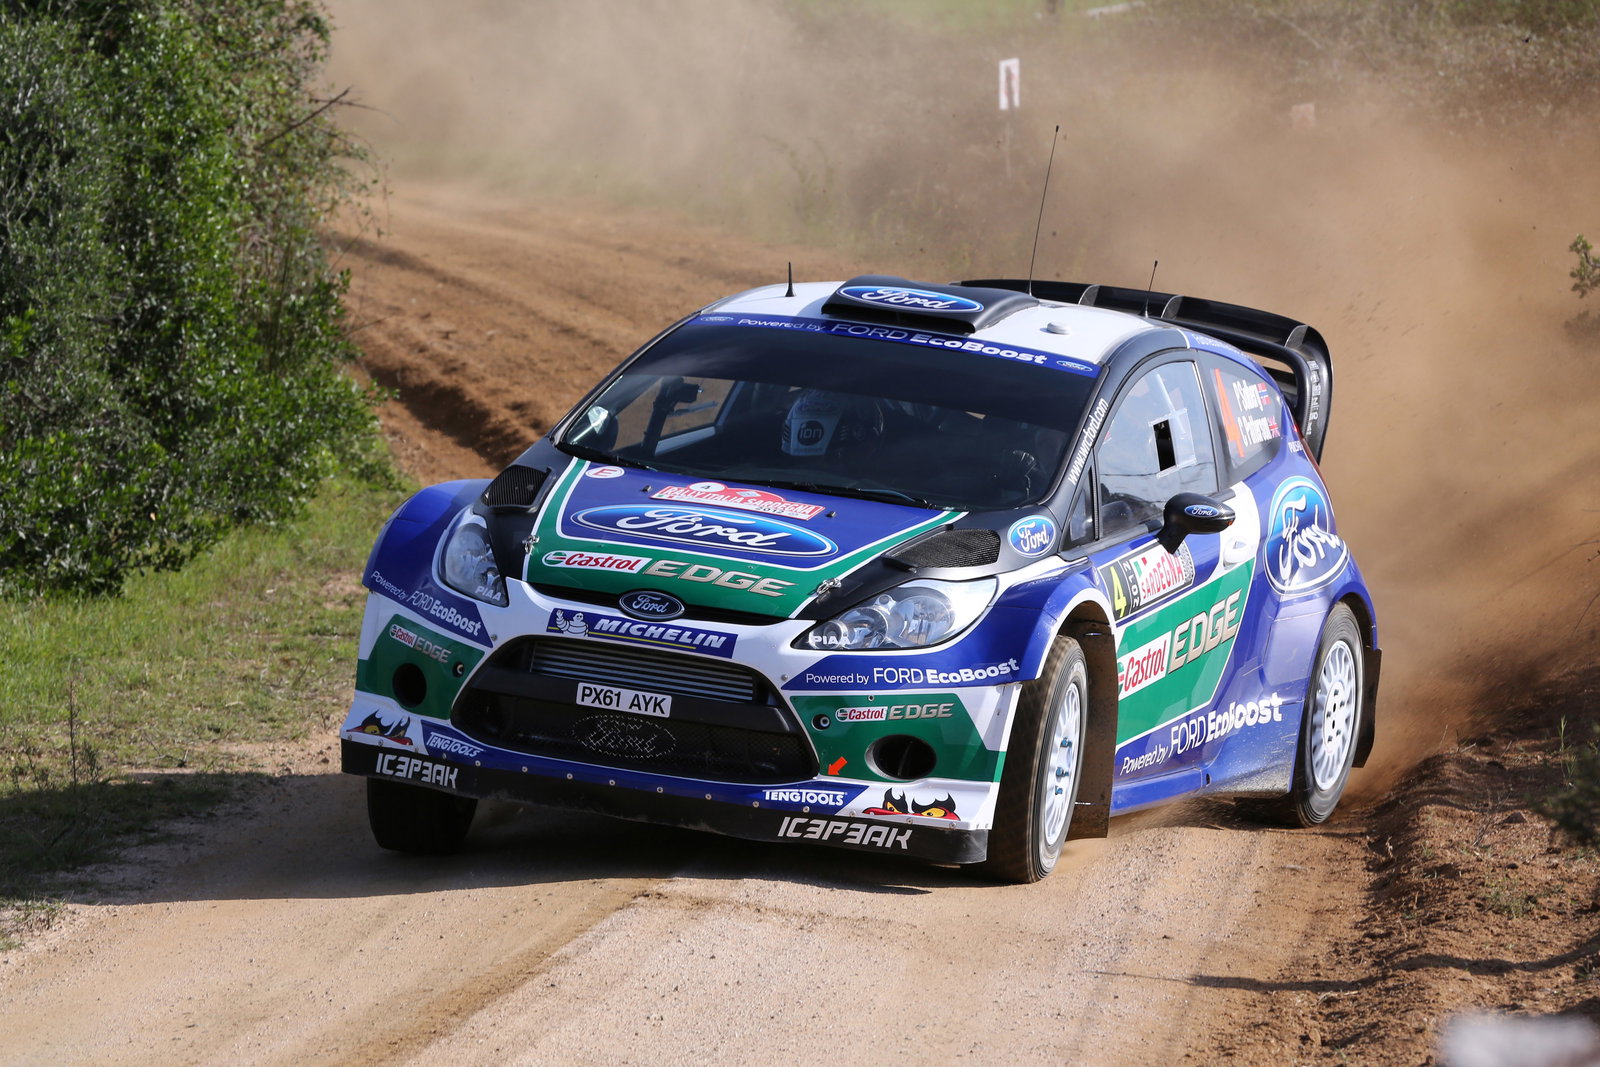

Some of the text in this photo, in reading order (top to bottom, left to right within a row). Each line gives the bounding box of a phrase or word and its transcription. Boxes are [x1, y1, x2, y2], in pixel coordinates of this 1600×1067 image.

[861, 288, 957, 309] Ford
[738, 318, 803, 329] Powered
[806, 322, 827, 332] by
[830, 323, 908, 341] FORD
[909, 334, 1047, 365] EcoBoost
[1068, 398, 1109, 486] www.wrcford.com
[594, 467, 617, 477] E
[664, 486, 817, 514] RALLY ITALIA SARDEGNA
[1191, 507, 1213, 516] Ford
[617, 507, 793, 549] Ford
[1018, 522, 1050, 552] Ford
[1279, 494, 1341, 588] Ford
[563, 553, 800, 597] Castrol EDGE
[1141, 552, 1185, 599] SARDEGNA
[371, 570, 400, 598] Powered
[407, 590, 433, 612] FORD
[431, 599, 482, 637] EcoBoost
[475, 585, 502, 601] PIAA
[631, 594, 670, 613] Ford
[1111, 565, 1127, 618] 4
[594, 618, 728, 649] MICHELIN
[813, 635, 851, 645] PIAA
[1124, 588, 1242, 692] Castrol EDGE
[415, 636, 453, 664] EDGE
[806, 658, 1020, 685] Powered by FORD EcoBoost
[581, 686, 667, 715] PX61 AYK
[848, 703, 955, 720] Castrol EDGE
[1120, 745, 1159, 776] Powered
[1168, 712, 1209, 758] FORD
[1206, 691, 1284, 742] EcoBoost
